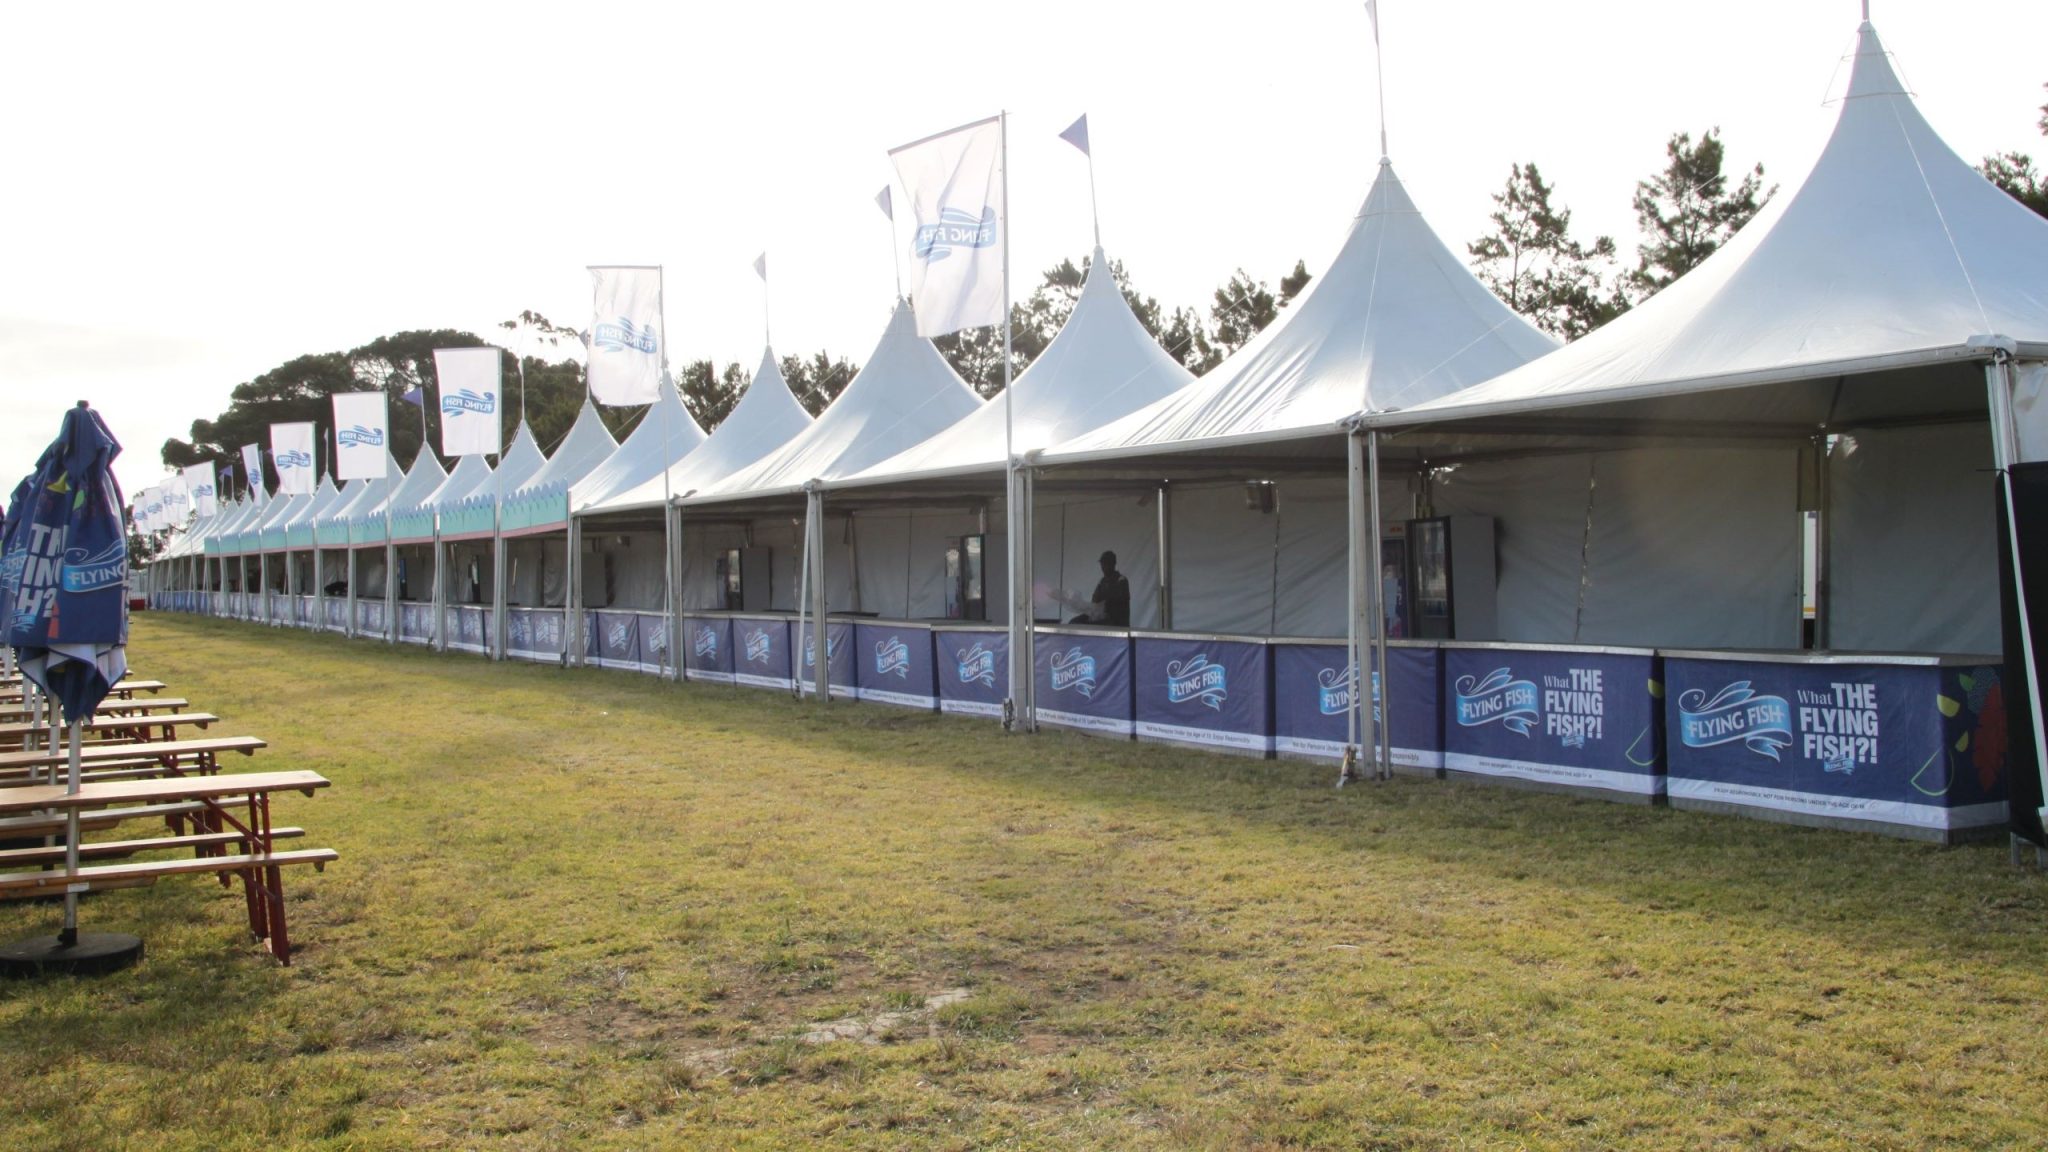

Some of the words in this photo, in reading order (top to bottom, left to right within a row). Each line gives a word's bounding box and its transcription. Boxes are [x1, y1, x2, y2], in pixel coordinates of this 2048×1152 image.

[1054, 666, 1077, 685] FLYING
[1077, 662, 1093, 676] FISH
[1171, 675, 1201, 697] FLYING
[1202, 671, 1223, 687] FISH
[1543, 675, 1570, 689] What
[1569, 668, 1603, 692] THE
[1460, 694, 1503, 718] FLYING
[1505, 688, 1535, 708] FISH
[1545, 690, 1603, 716] FLYING
[1797, 689, 1833, 705] What
[1830, 682, 1878, 709] THE
[1547, 713, 1602, 739] FISH?!
[1687, 711, 1745, 738] FLYING
[1747, 704, 1785, 726] FISH
[1799, 706, 1879, 737] FLYING
[1804, 733, 1878, 764] FISH?!
